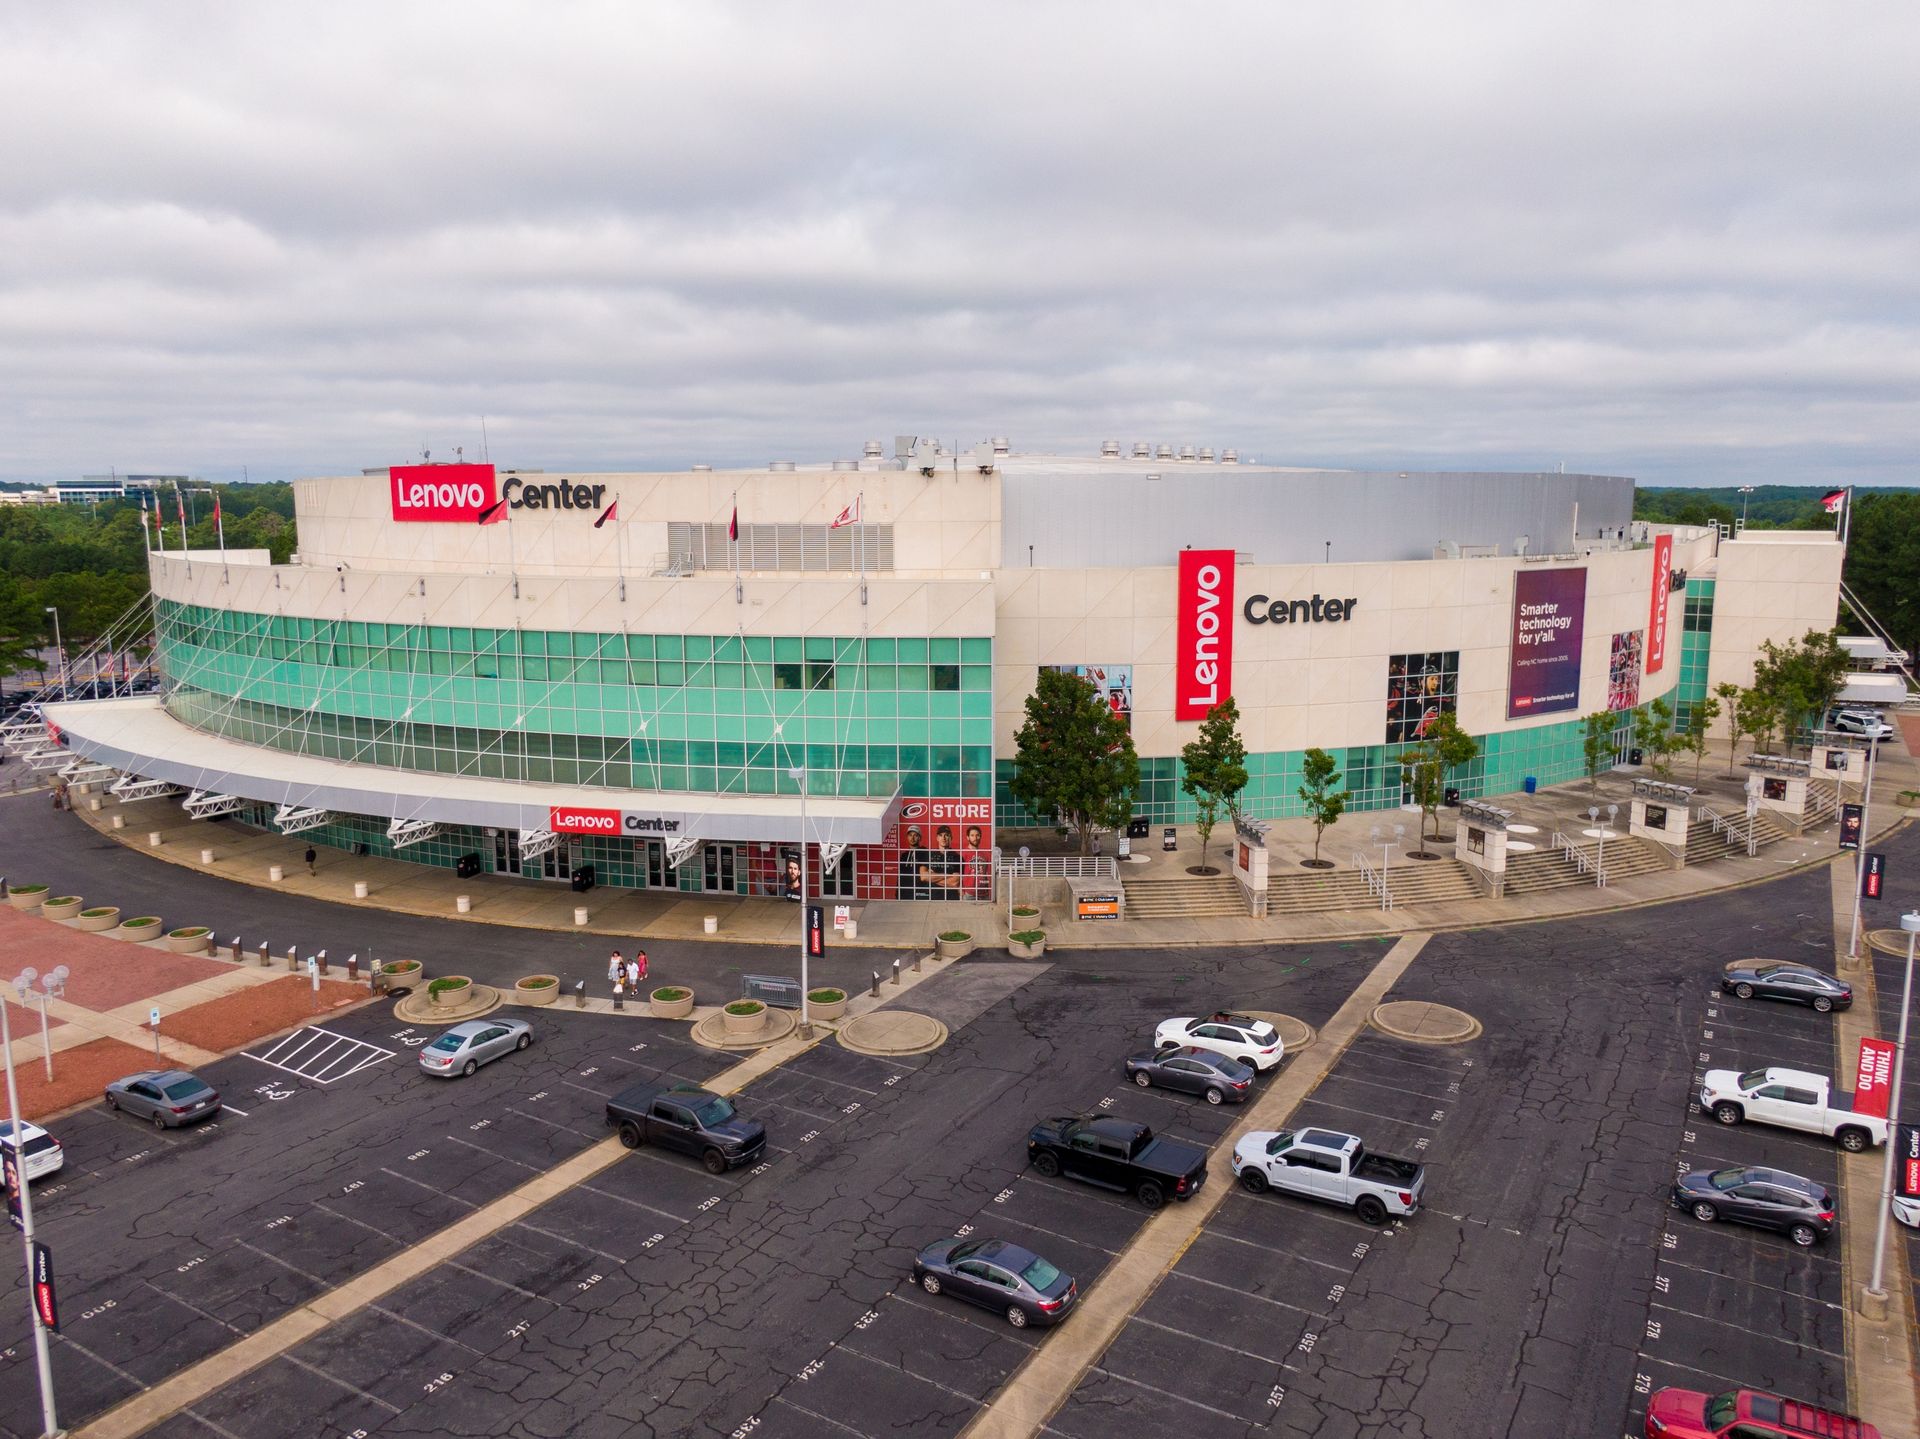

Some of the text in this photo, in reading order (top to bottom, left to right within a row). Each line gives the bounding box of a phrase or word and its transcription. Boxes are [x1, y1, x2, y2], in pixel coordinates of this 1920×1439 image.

[398, 478, 605, 509] Lenovo Center
[1520, 603, 1558, 616] Smarter
[1653, 547, 1668, 660] Lenovo
[1519, 616, 1572, 630] technology
[1189, 565, 1357, 705] Lenovo Center
[1519, 629, 1555, 646] for y'all.
[933, 804, 989, 818] STORE
[556, 813, 679, 832] Lenovo Center
[1858, 1046, 1876, 1091] AND DO
[1874, 1050, 1891, 1085] THINK
[800, 1130, 820, 1143] 222
[751, 1162, 772, 1175] 221
[1908, 1130, 1919, 1192] Lenovo Center
[697, 1196, 721, 1211] 220
[953, 1224, 974, 1239] 231
[1664, 1233, 1678, 1249] 276
[577, 1274, 603, 1290] 218
[1655, 1275, 1670, 1293] 277
[1327, 1284, 1346, 1303] 259
[40, 1287, 52, 1322] Lenovo
[507, 1320, 531, 1338] 217
[1646, 1320, 1662, 1339] 278
[1298, 1332, 1318, 1352] 258
[423, 1372, 454, 1393] 216
[1635, 1372, 1652, 1394] 279
[1267, 1384, 1286, 1408] 257
